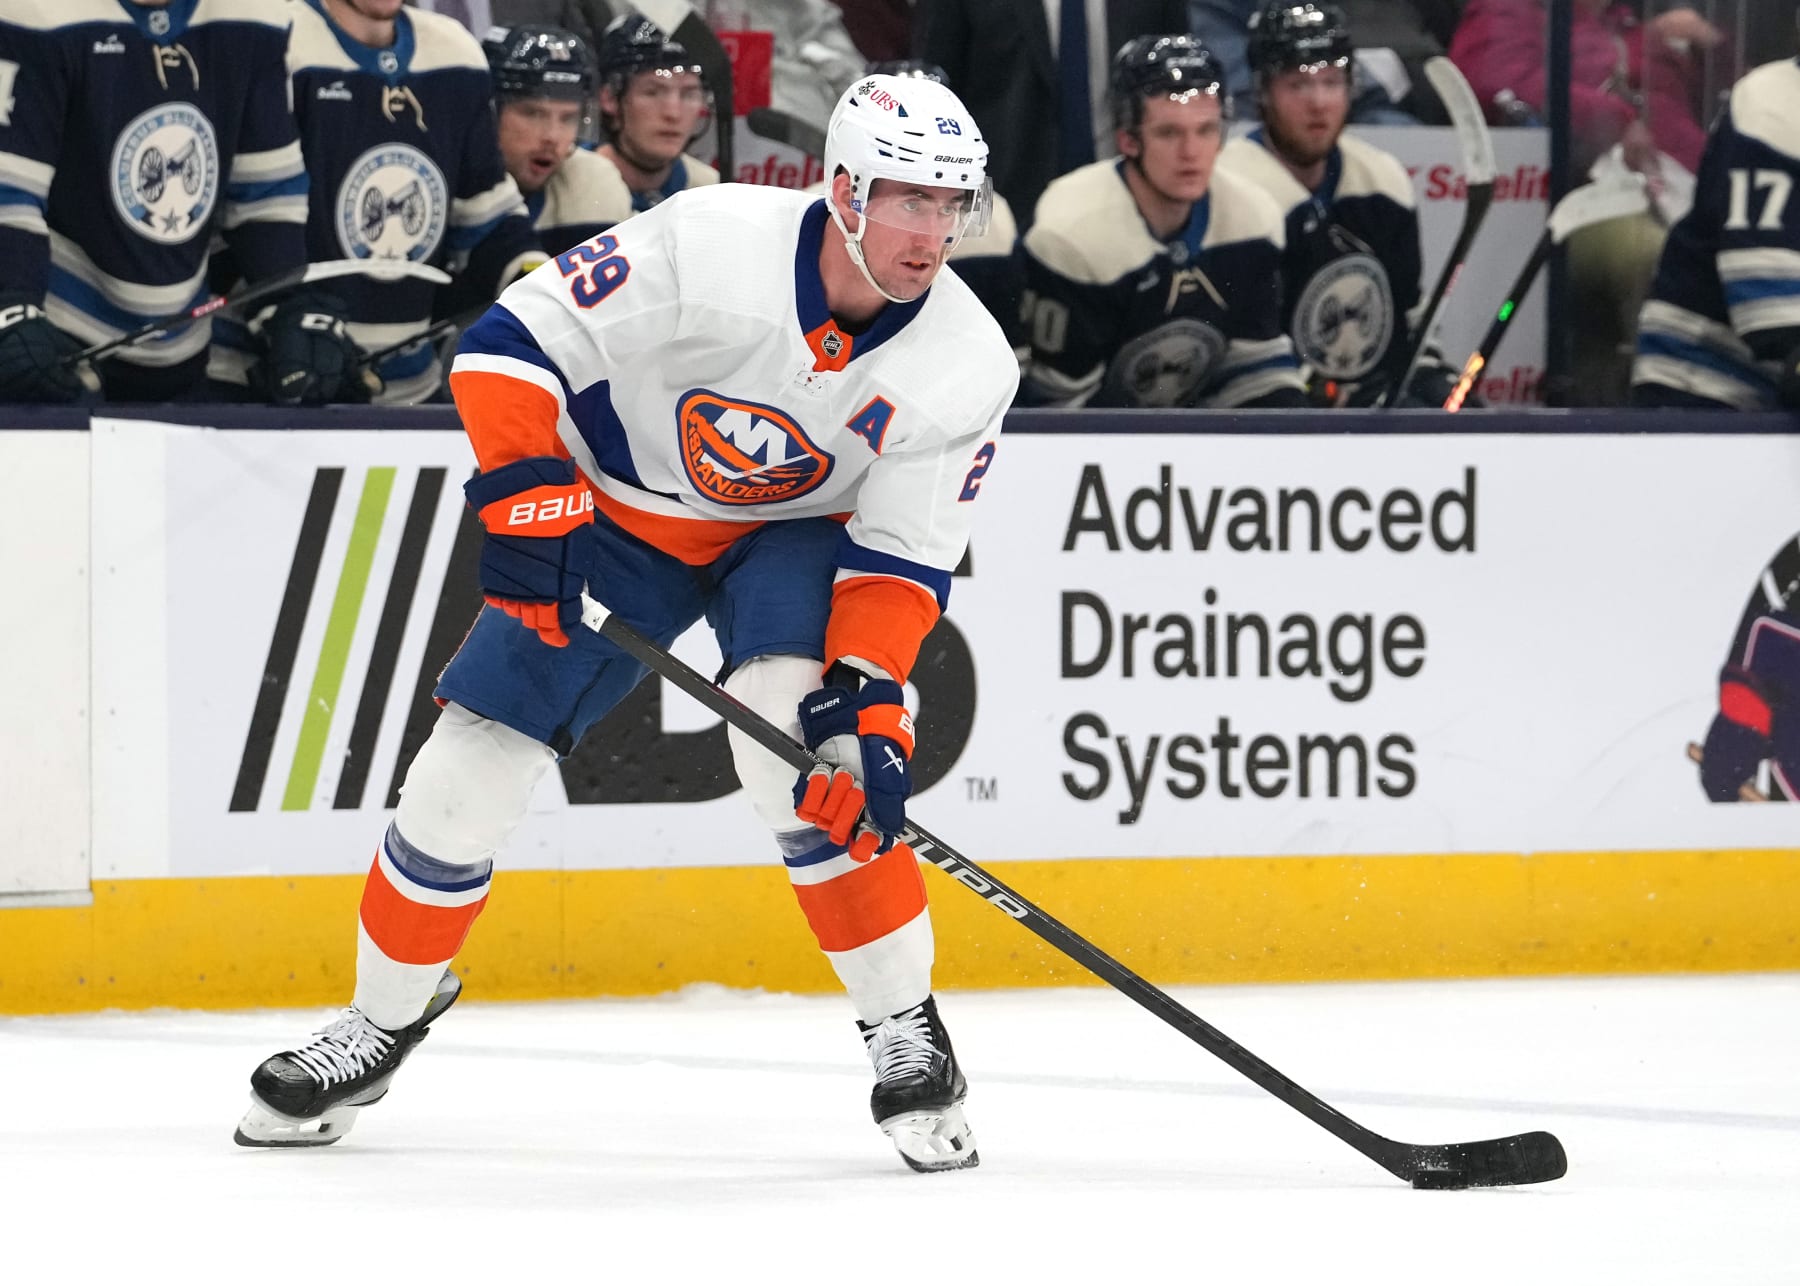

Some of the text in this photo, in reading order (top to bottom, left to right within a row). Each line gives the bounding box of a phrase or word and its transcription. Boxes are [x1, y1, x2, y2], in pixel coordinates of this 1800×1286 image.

[870, 89, 899, 111] UBS
[936, 117, 962, 136] 29
[934, 154, 974, 165] BAUER
[1724, 168, 1794, 230] 17
[554, 235, 631, 310] 29
[845, 394, 897, 457] A
[687, 426, 798, 498] ISLANDERS
[957, 441, 997, 502] 2
[1062, 464, 1477, 552] Advanced
[1060, 586, 1427, 702] Drainage
[965, 776, 998, 802] TM
[1061, 710, 1417, 825] Systems
